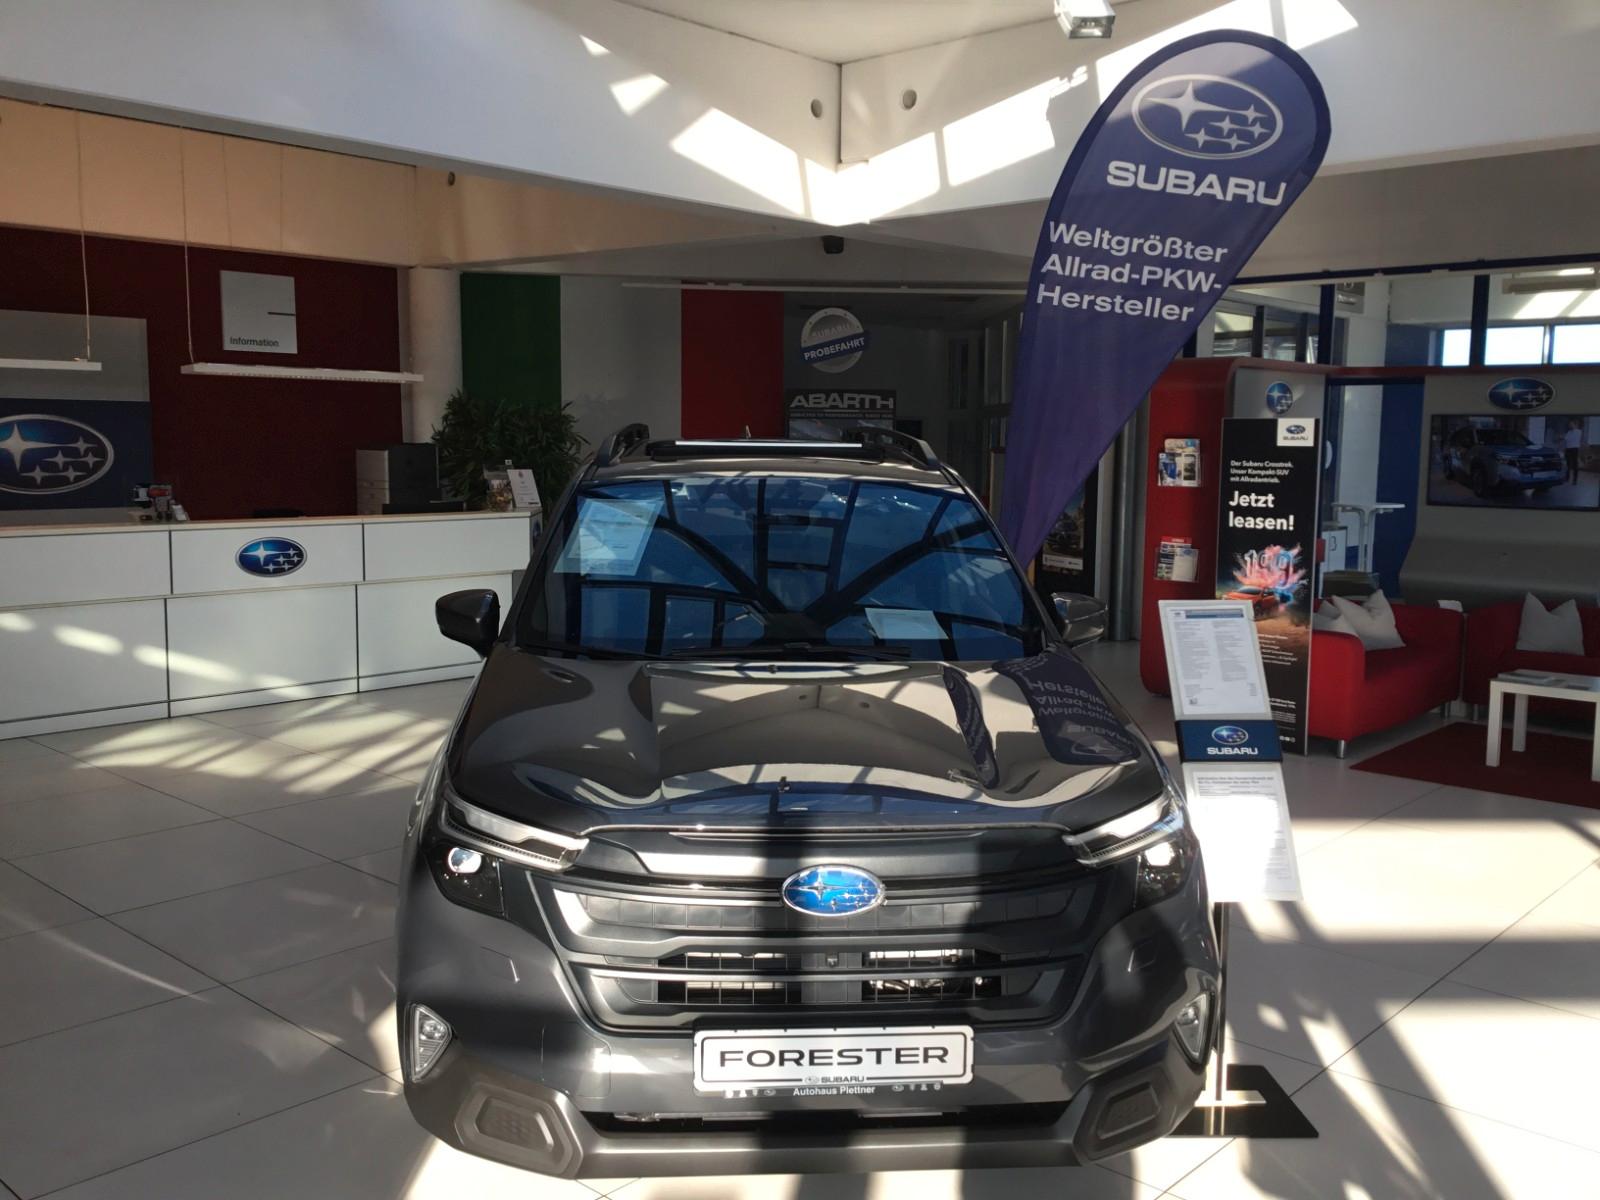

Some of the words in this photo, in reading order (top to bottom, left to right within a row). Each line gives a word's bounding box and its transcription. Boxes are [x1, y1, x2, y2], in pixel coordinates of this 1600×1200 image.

[1106, 160, 1287, 206] SUBARU
[1049, 221, 1228, 263] Weltgrößter
[1041, 253, 1222, 293] Allrad-PKW-
[1037, 284, 1195, 322] Hersteller
[229, 336, 280, 347] Information
[803, 336, 866, 361] PROBEFAHRT
[789, 392, 894, 409] ABARTH
[1228, 490, 1276, 508] Jetzt
[1228, 510, 1295, 531] leasen!
[1206, 747, 1259, 755] SUBARU
[719, 1046, 949, 1068] FORESTER
[820, 1075, 865, 1084] SUBARU
[793, 1086, 838, 1096] Autohaus
